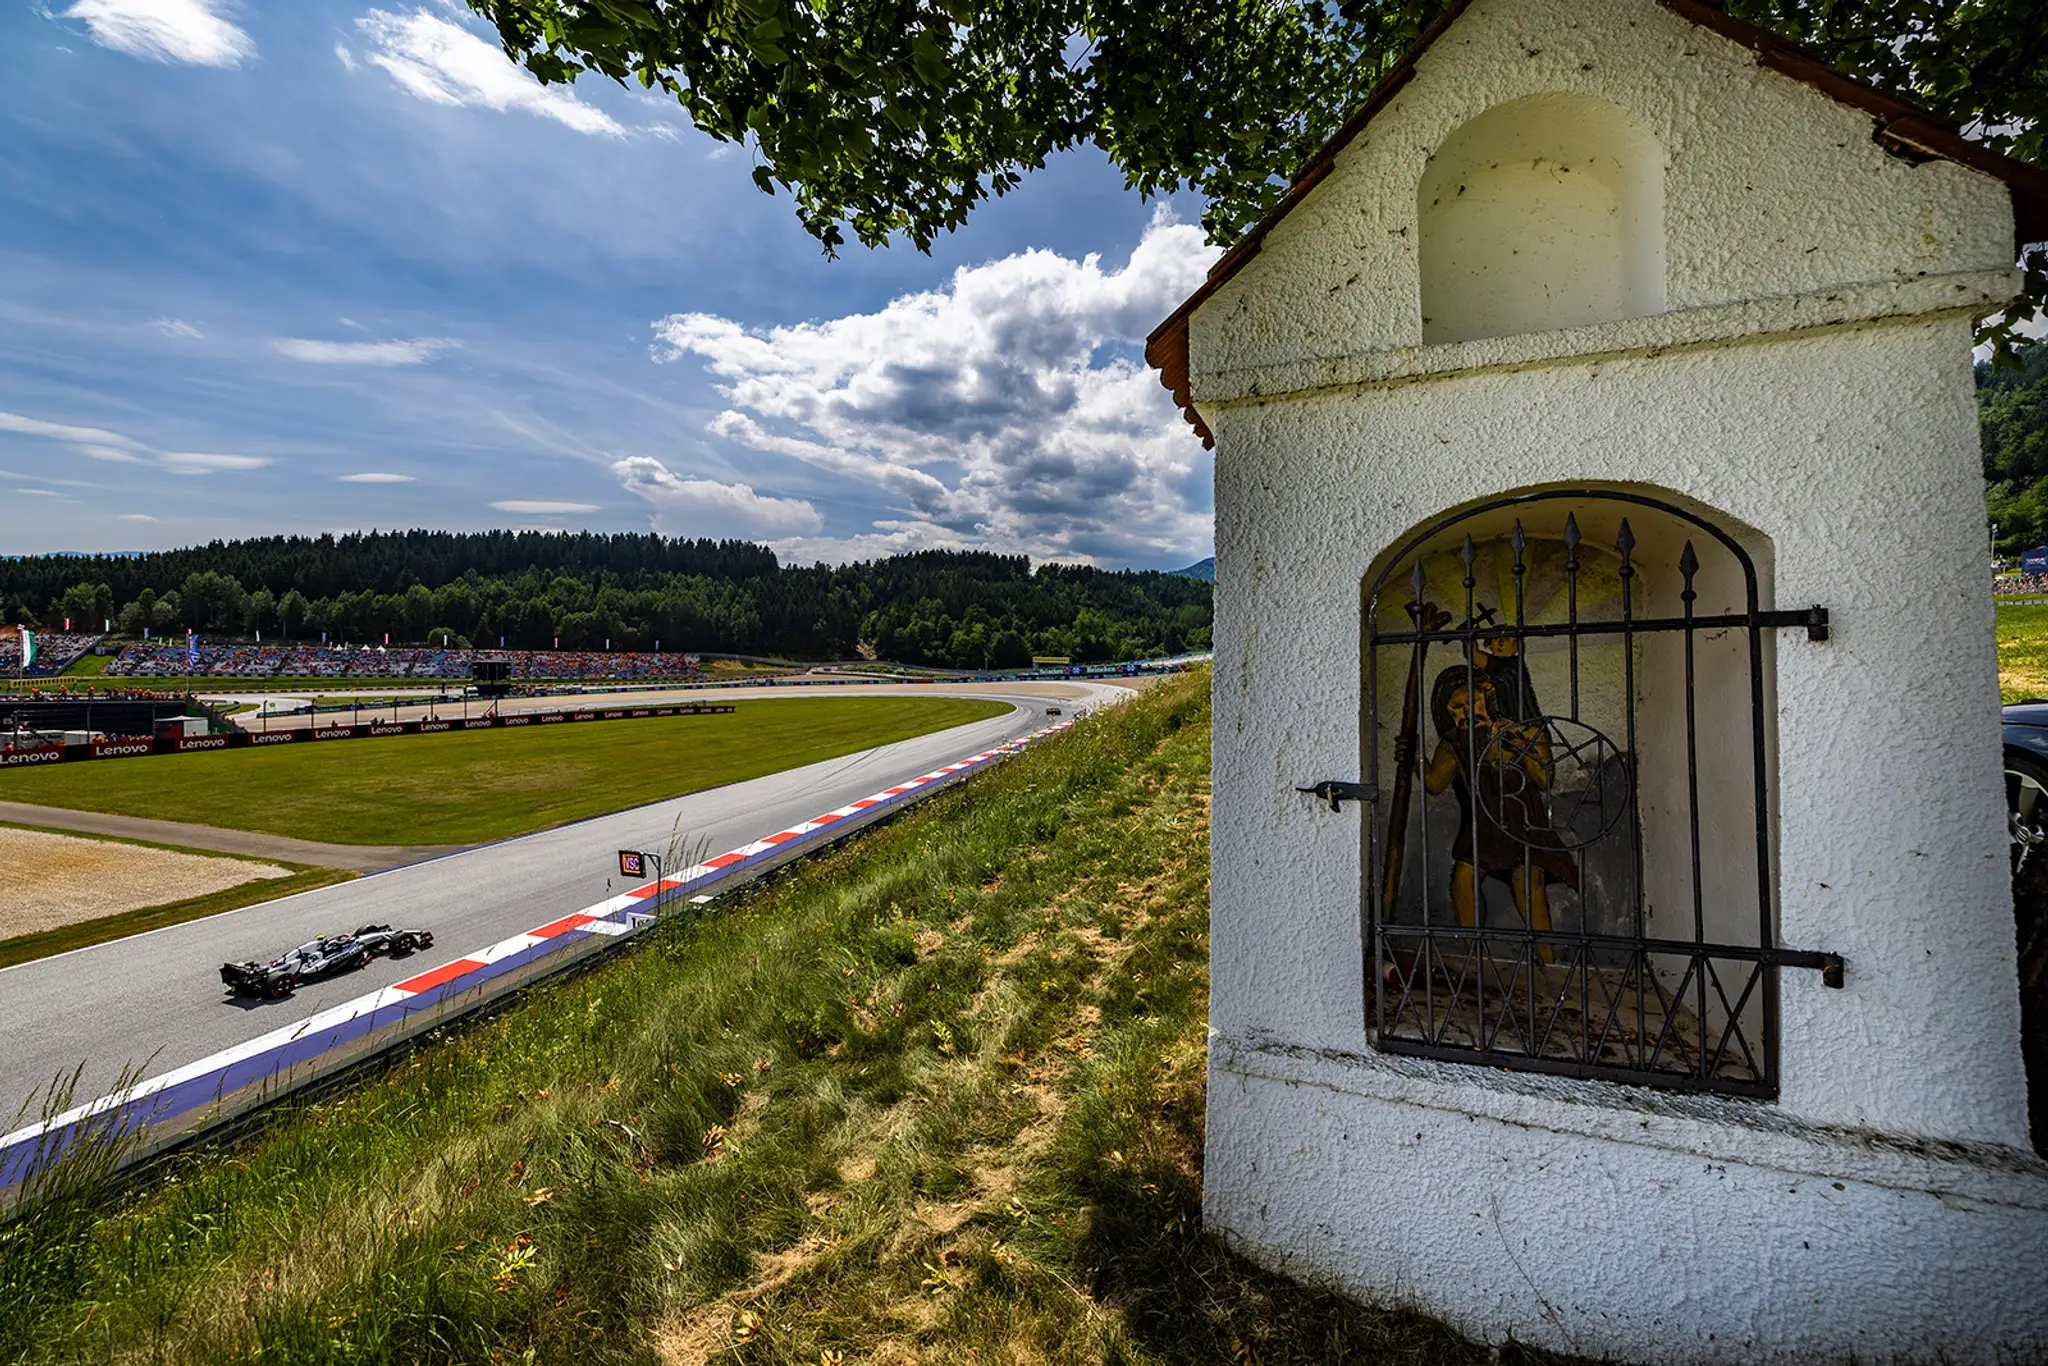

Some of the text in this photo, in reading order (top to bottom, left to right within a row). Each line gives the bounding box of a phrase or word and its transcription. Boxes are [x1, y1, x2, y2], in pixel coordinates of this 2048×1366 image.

[505, 717, 529, 725] Lenovo
[541, 714, 563, 722] Lenovo
[574, 712, 595, 720] Lenovo
[421, 720, 449, 731] Lenovo
[465, 719, 491, 728] Lenovo
[315, 729, 351, 739] Lenovo
[371, 724, 403, 735] Lenovo
[180, 738, 225, 749] Lenovo
[252, 733, 292, 744] Lenovo
[96, 744, 148, 756] Lenovo
[0, 751, 59, 764] Lenovo
[625, 857, 640, 870] VSC
